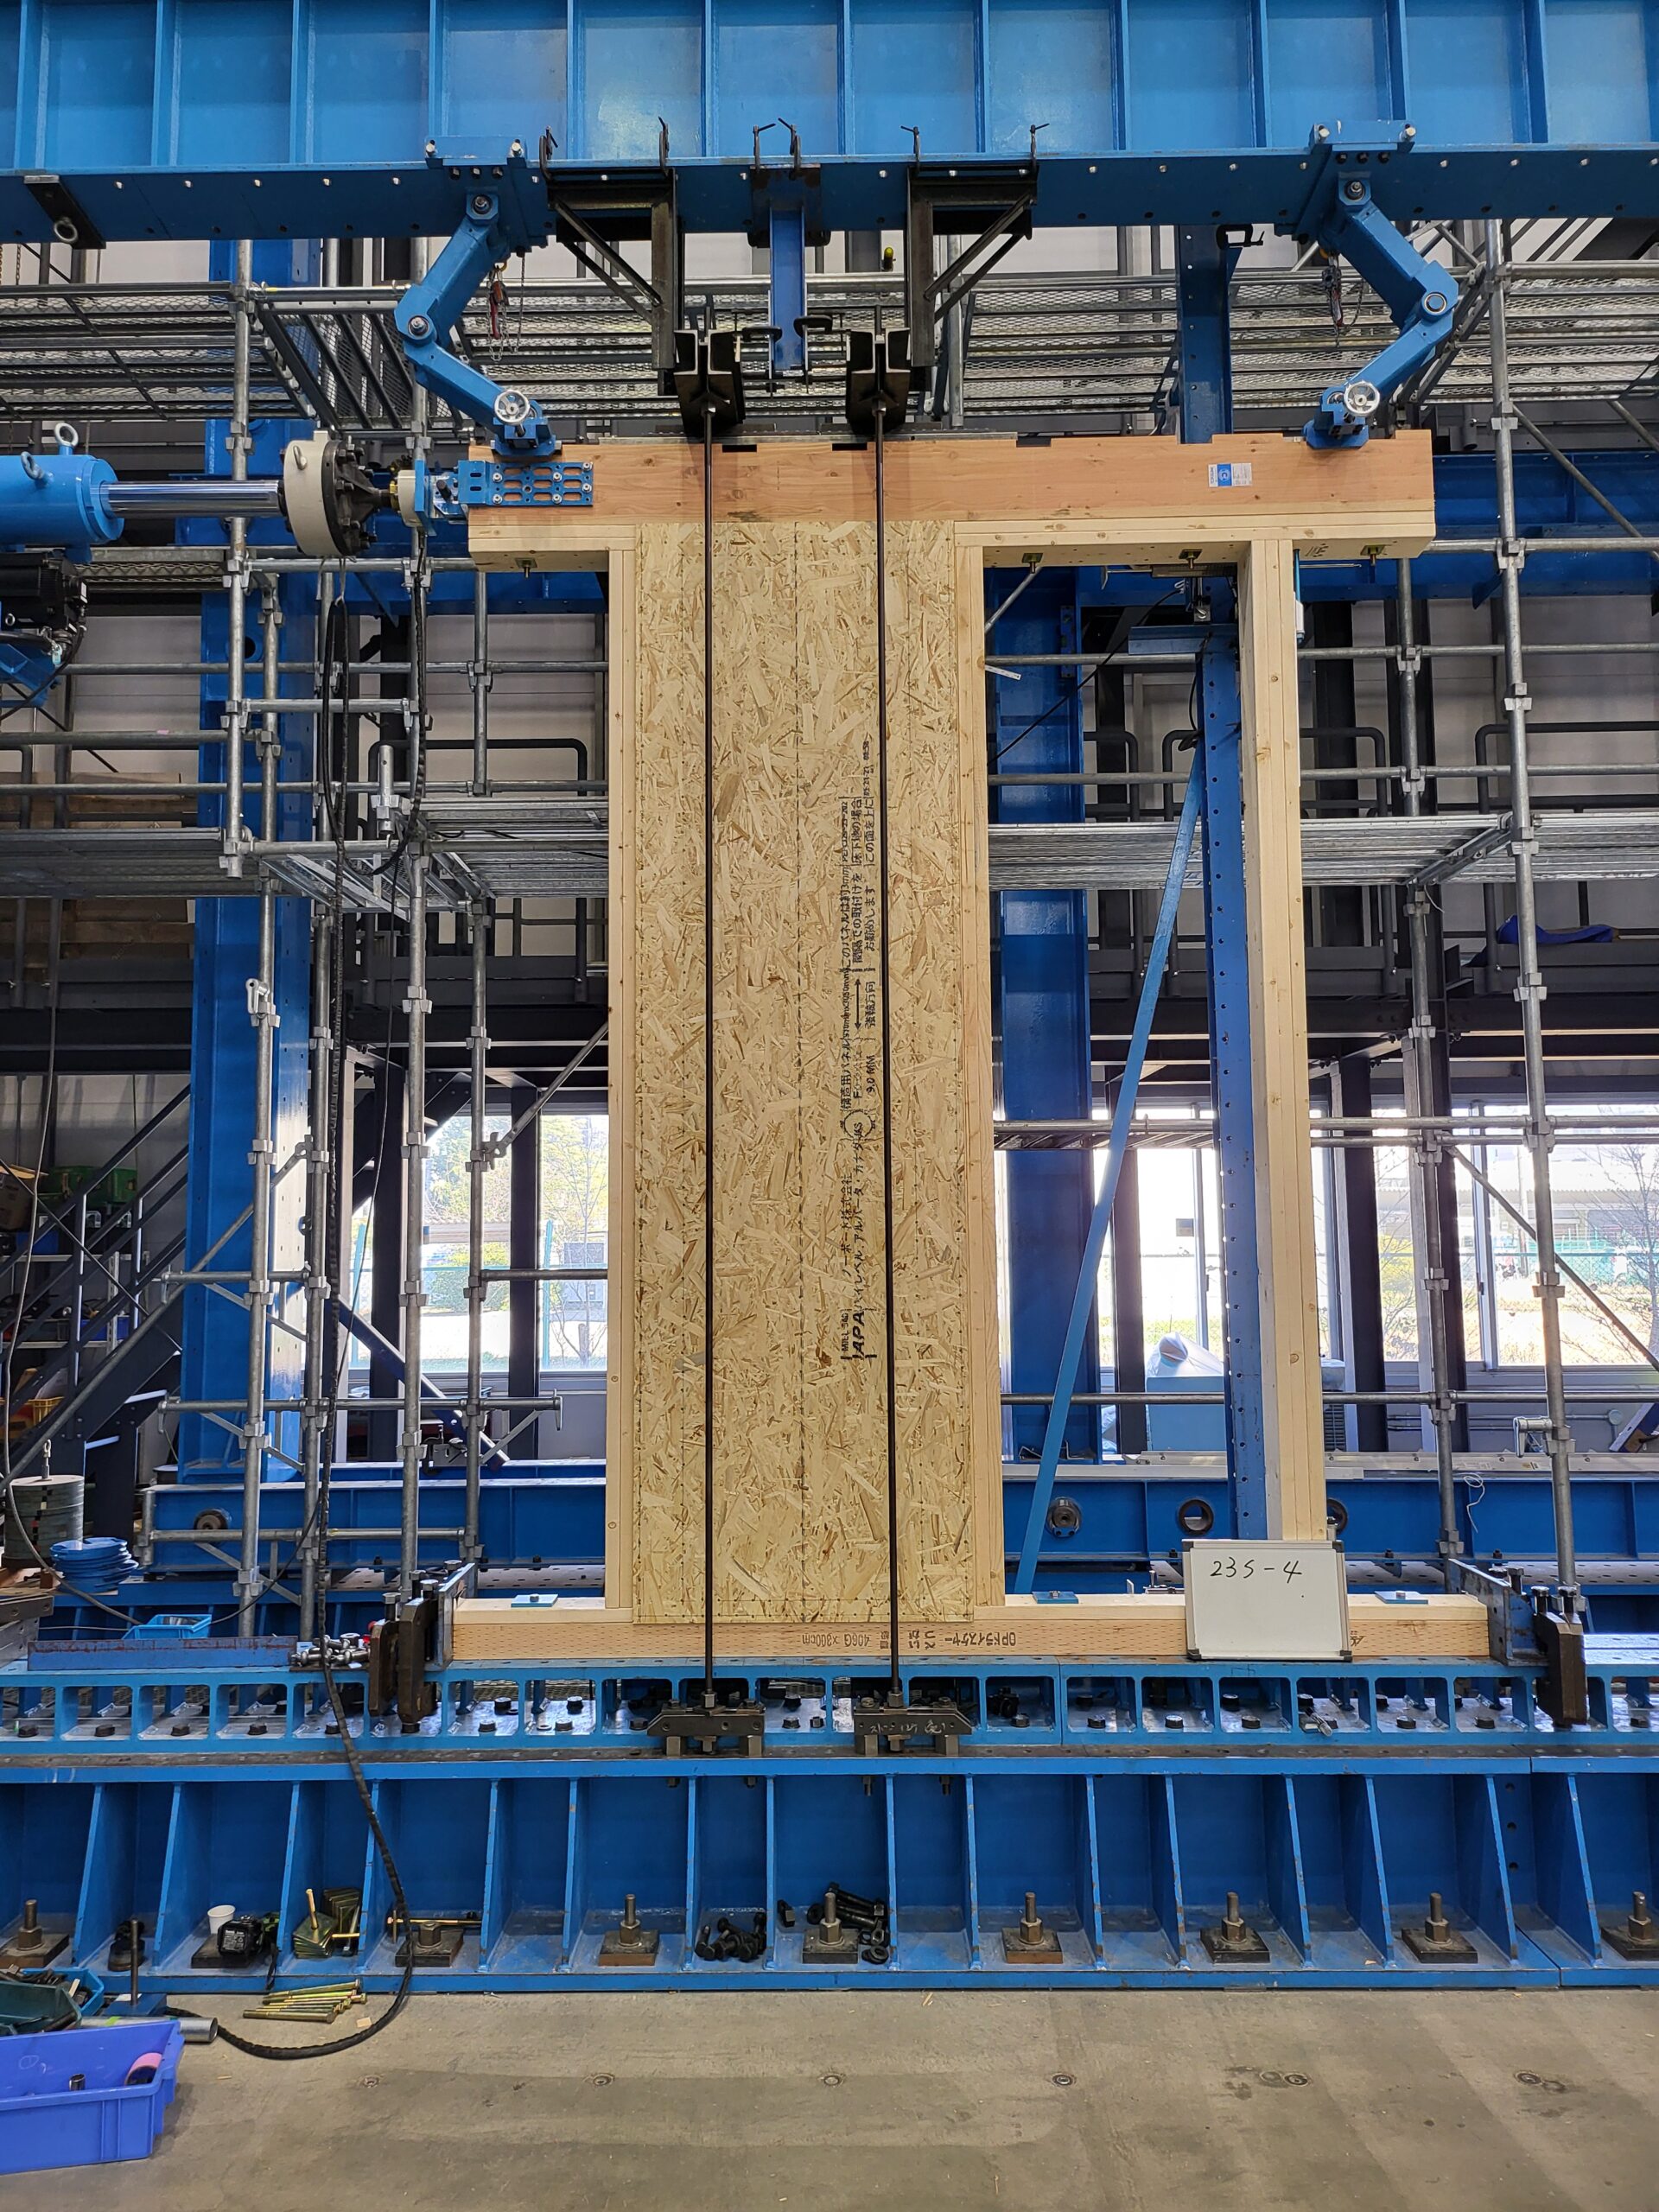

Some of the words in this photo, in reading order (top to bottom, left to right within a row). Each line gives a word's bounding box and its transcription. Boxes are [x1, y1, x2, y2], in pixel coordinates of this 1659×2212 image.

[863, 799, 875, 863] この面を上に
[851, 873, 863, 963] 間隔での取付けを
[864, 981, 876, 1029] 強軸方向
[840, 1041, 852, 1109] 構造用パネル
[866, 1077, 875, 1093] 9.0
[854, 1122, 863, 1139] JAS
[840, 1172, 852, 1277] ノーボード株式会社
[852, 1310, 865, 1355] APA
[843, 1633, 870, 1648] 406G
